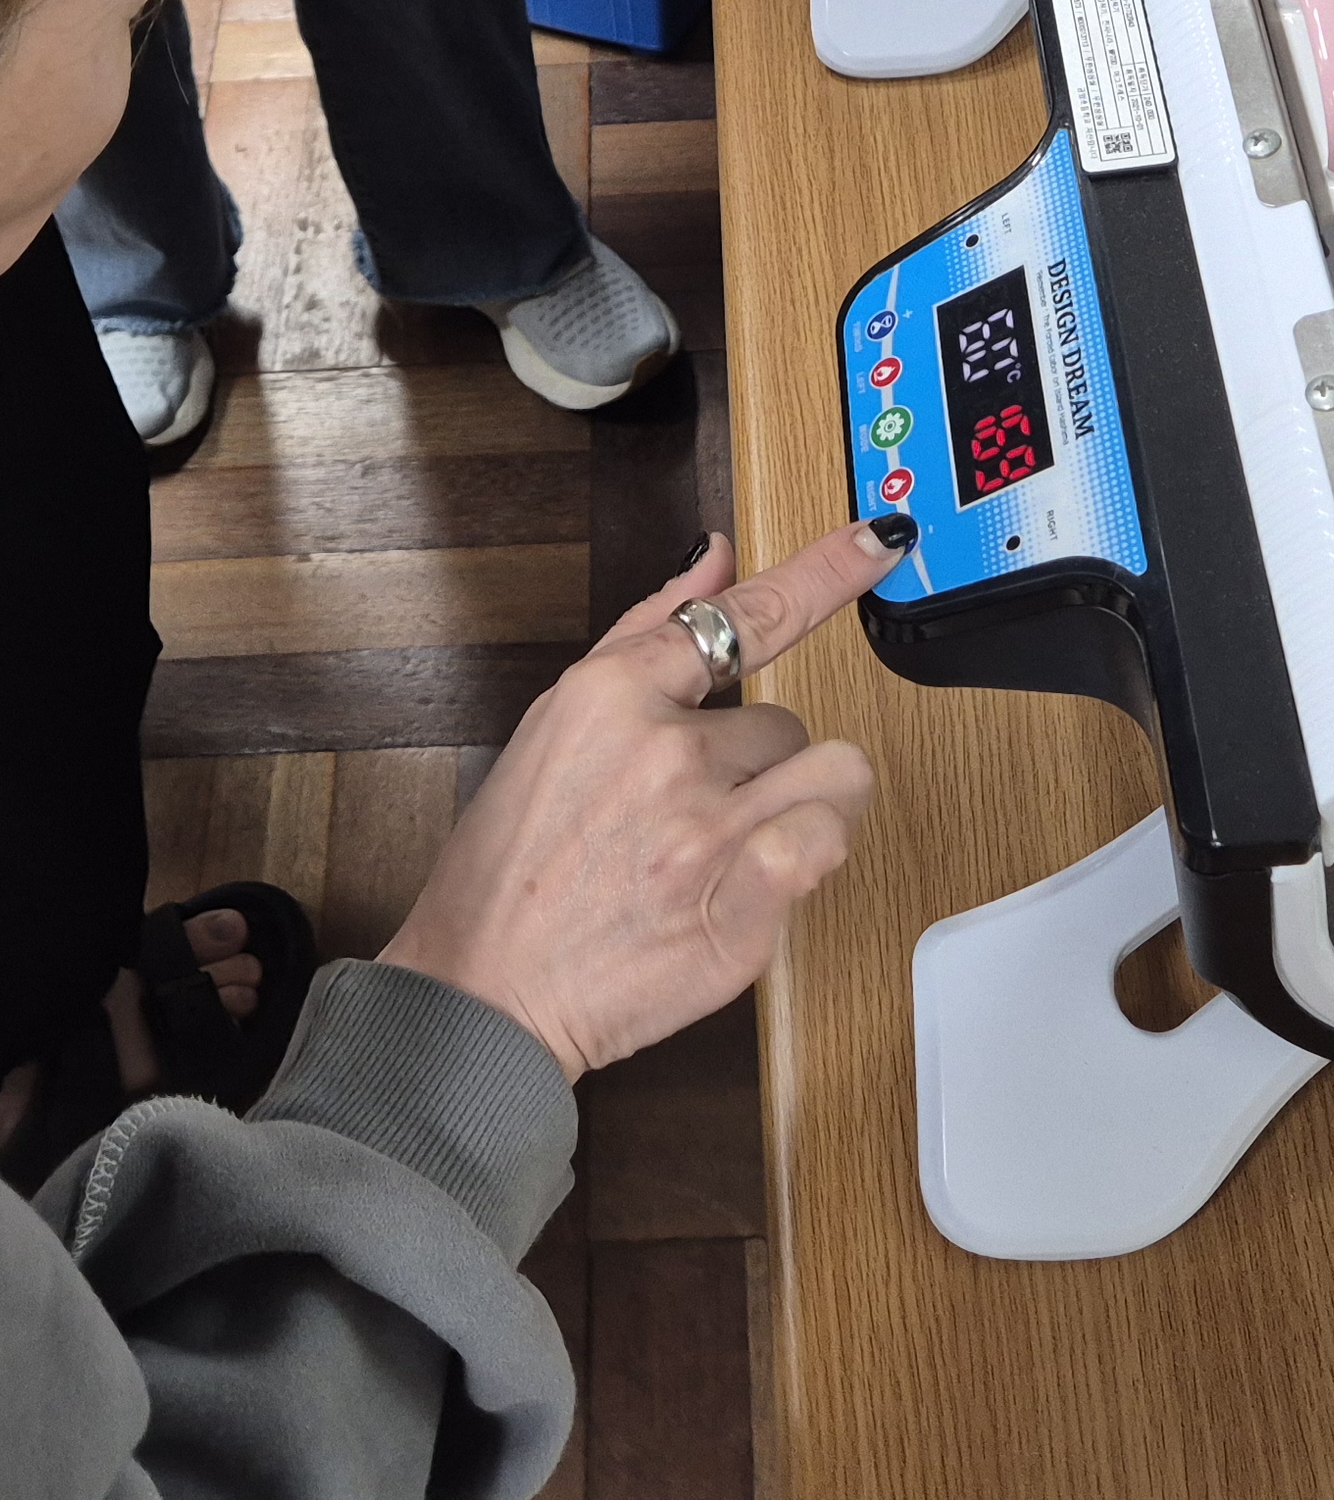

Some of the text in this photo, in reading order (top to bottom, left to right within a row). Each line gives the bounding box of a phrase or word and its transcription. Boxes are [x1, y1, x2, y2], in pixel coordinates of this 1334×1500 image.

[1001, 212, 1011, 234] LEFT
[1047, 257, 1095, 440] DESIGN DREAM
[971, 404, 1036, 492] 169
[1047, 510, 1057, 540] RIGHT
